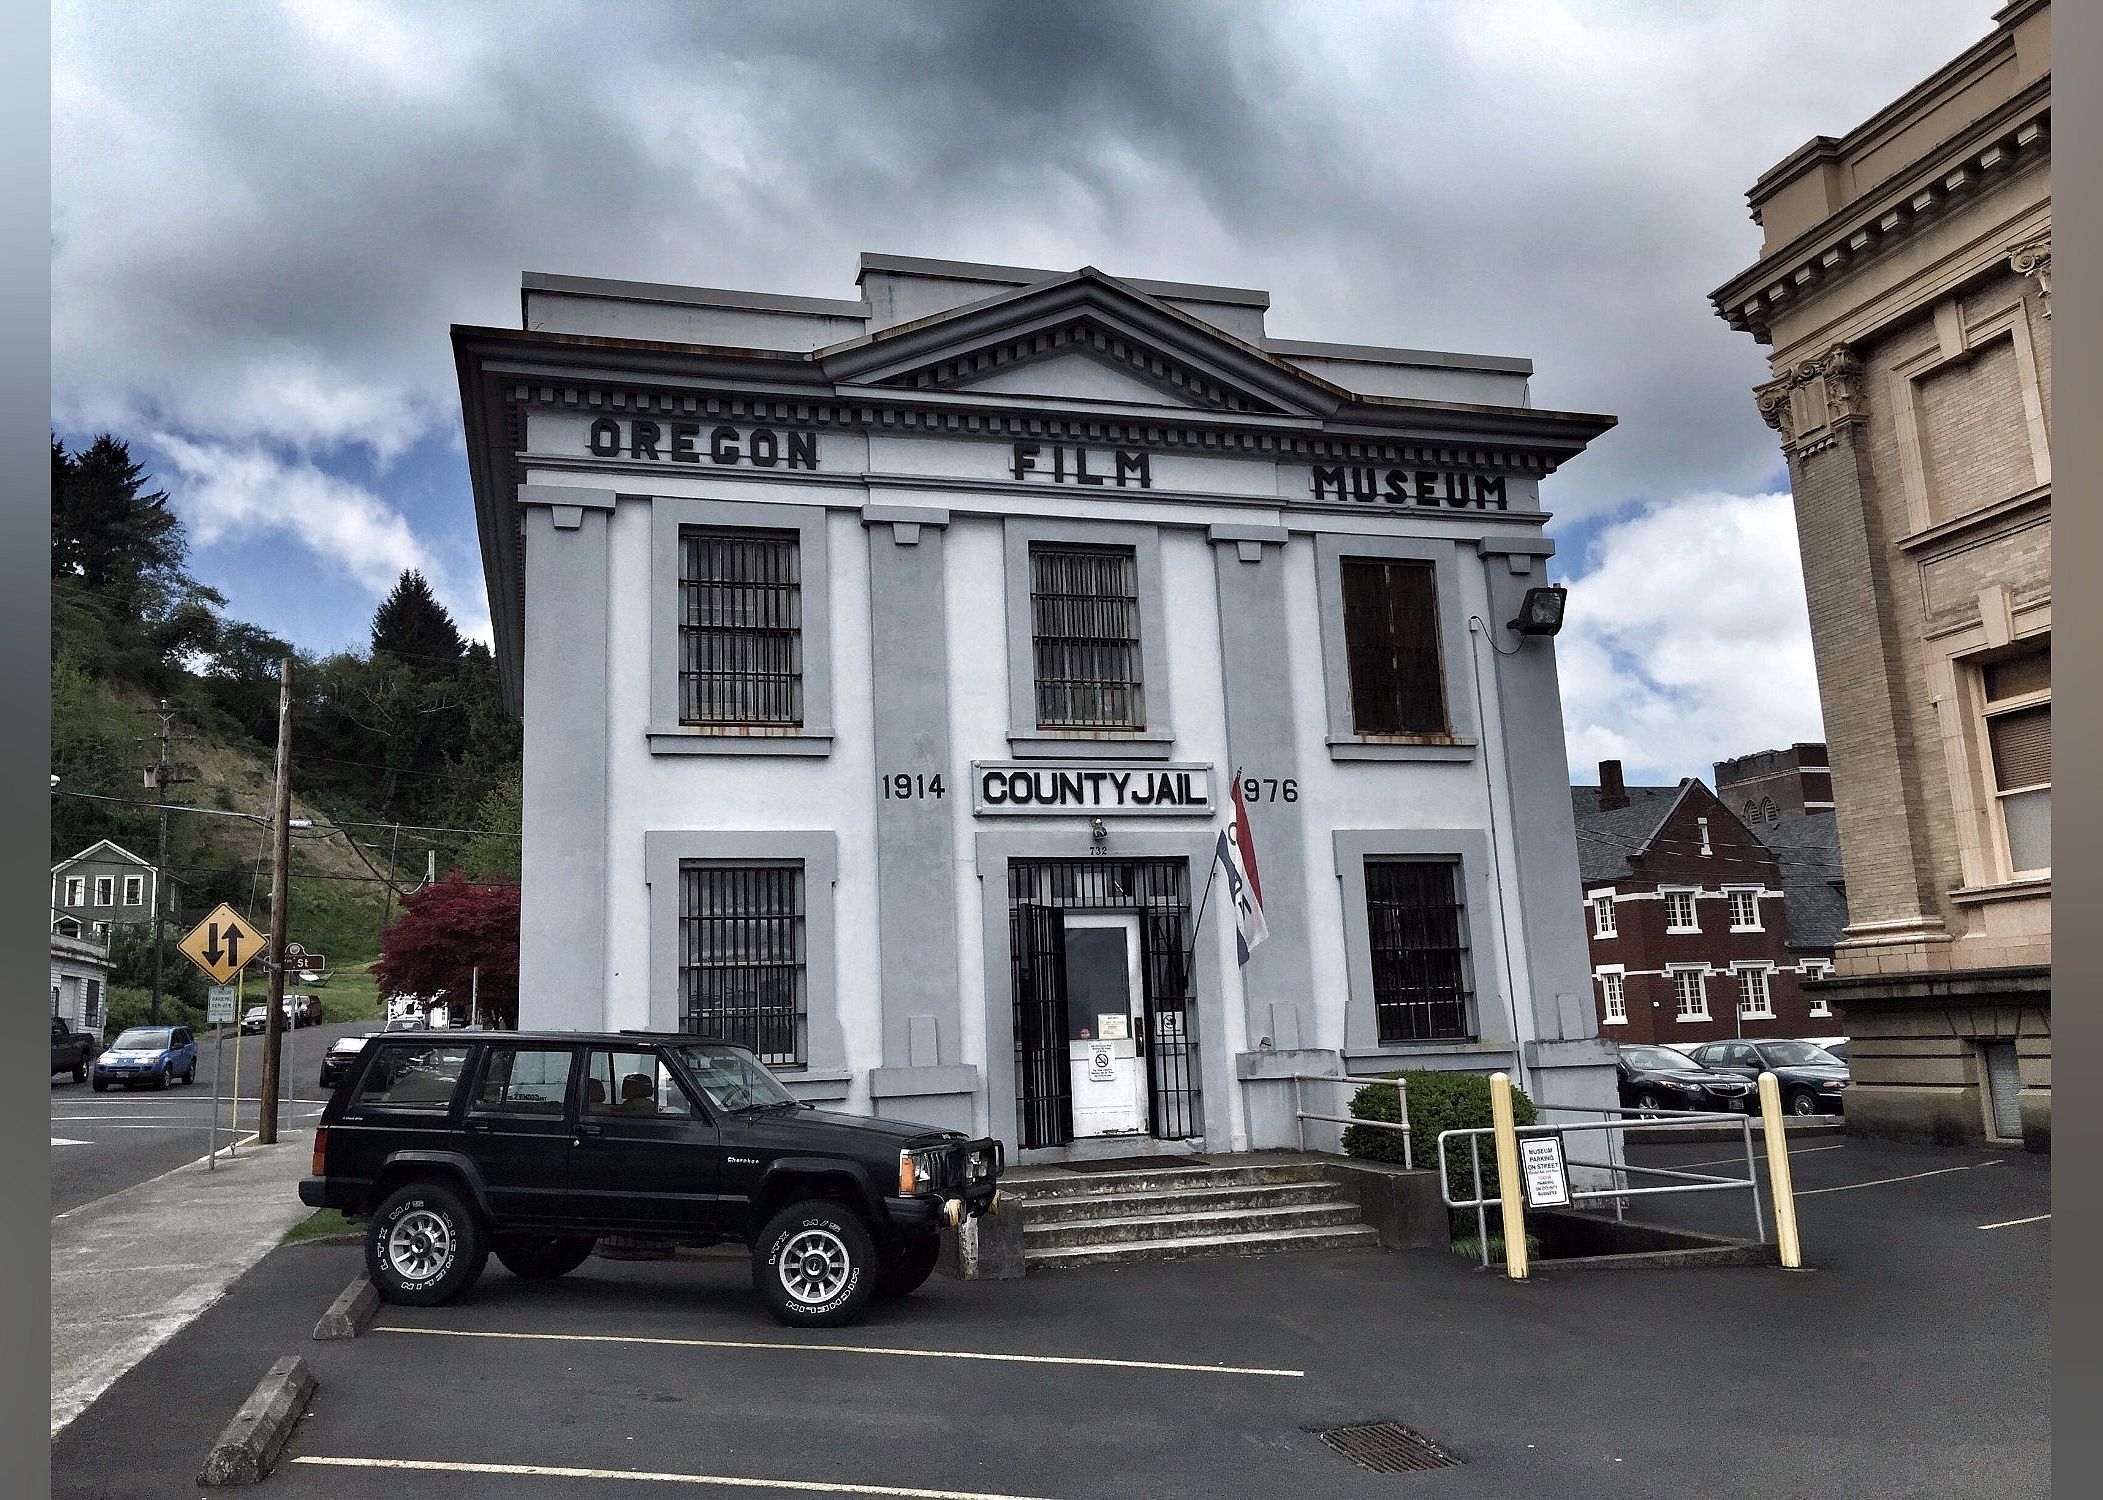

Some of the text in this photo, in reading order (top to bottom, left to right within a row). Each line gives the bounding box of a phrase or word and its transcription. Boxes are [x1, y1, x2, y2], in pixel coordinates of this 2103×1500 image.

[590, 417, 1508, 511] OREGON FILM MUSEUM
[883, 773, 946, 800] 1914
[1244, 778, 1299, 803] 976
[1089, 846, 1108, 856] 732
[297, 958, 309, 968] St
[727, 1156, 760, 1164] Cherokee
[377, 1227, 389, 1271] LTX
[401, 1212, 457, 1290] MICHELIN
[768, 1218, 841, 1265] LTX M/S
[785, 1267, 860, 1314] MICHELIN
